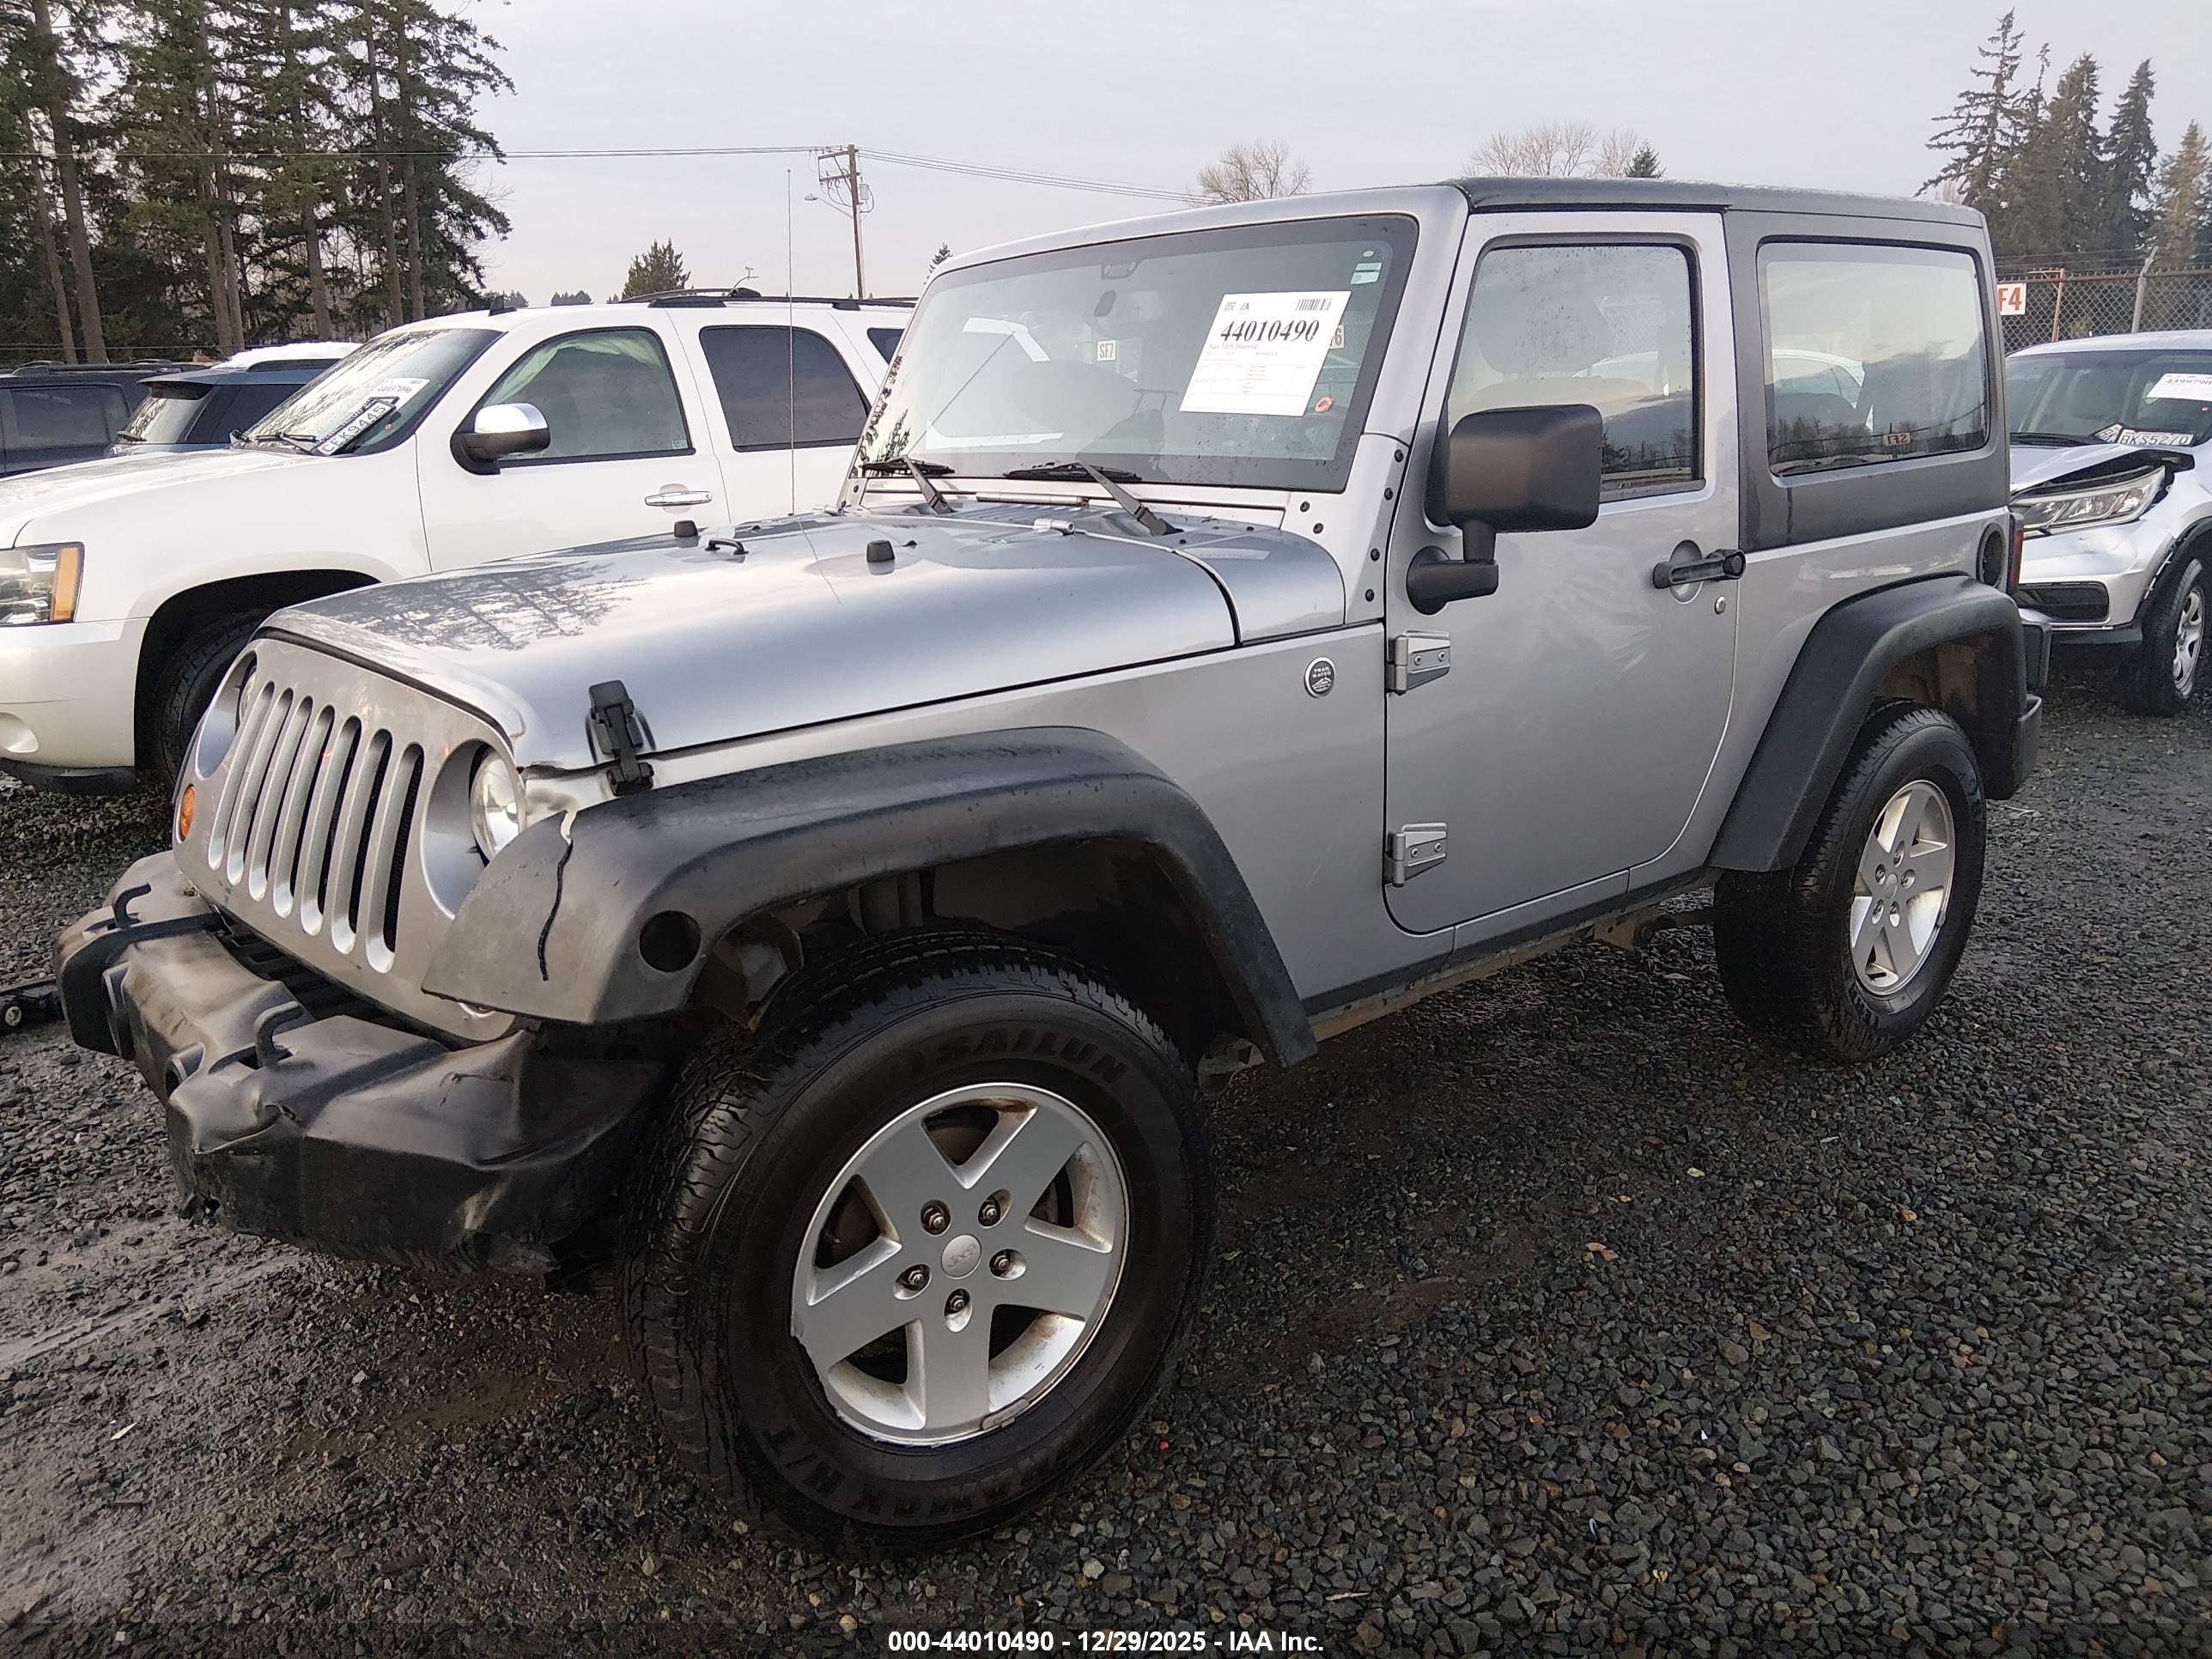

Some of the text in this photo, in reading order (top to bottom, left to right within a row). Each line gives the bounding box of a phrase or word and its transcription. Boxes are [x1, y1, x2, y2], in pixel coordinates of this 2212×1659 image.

[1220, 319, 1320, 342] 44010490
[1099, 343, 1114, 359] SF7
[935, 1029, 1129, 1085] SAILUN
